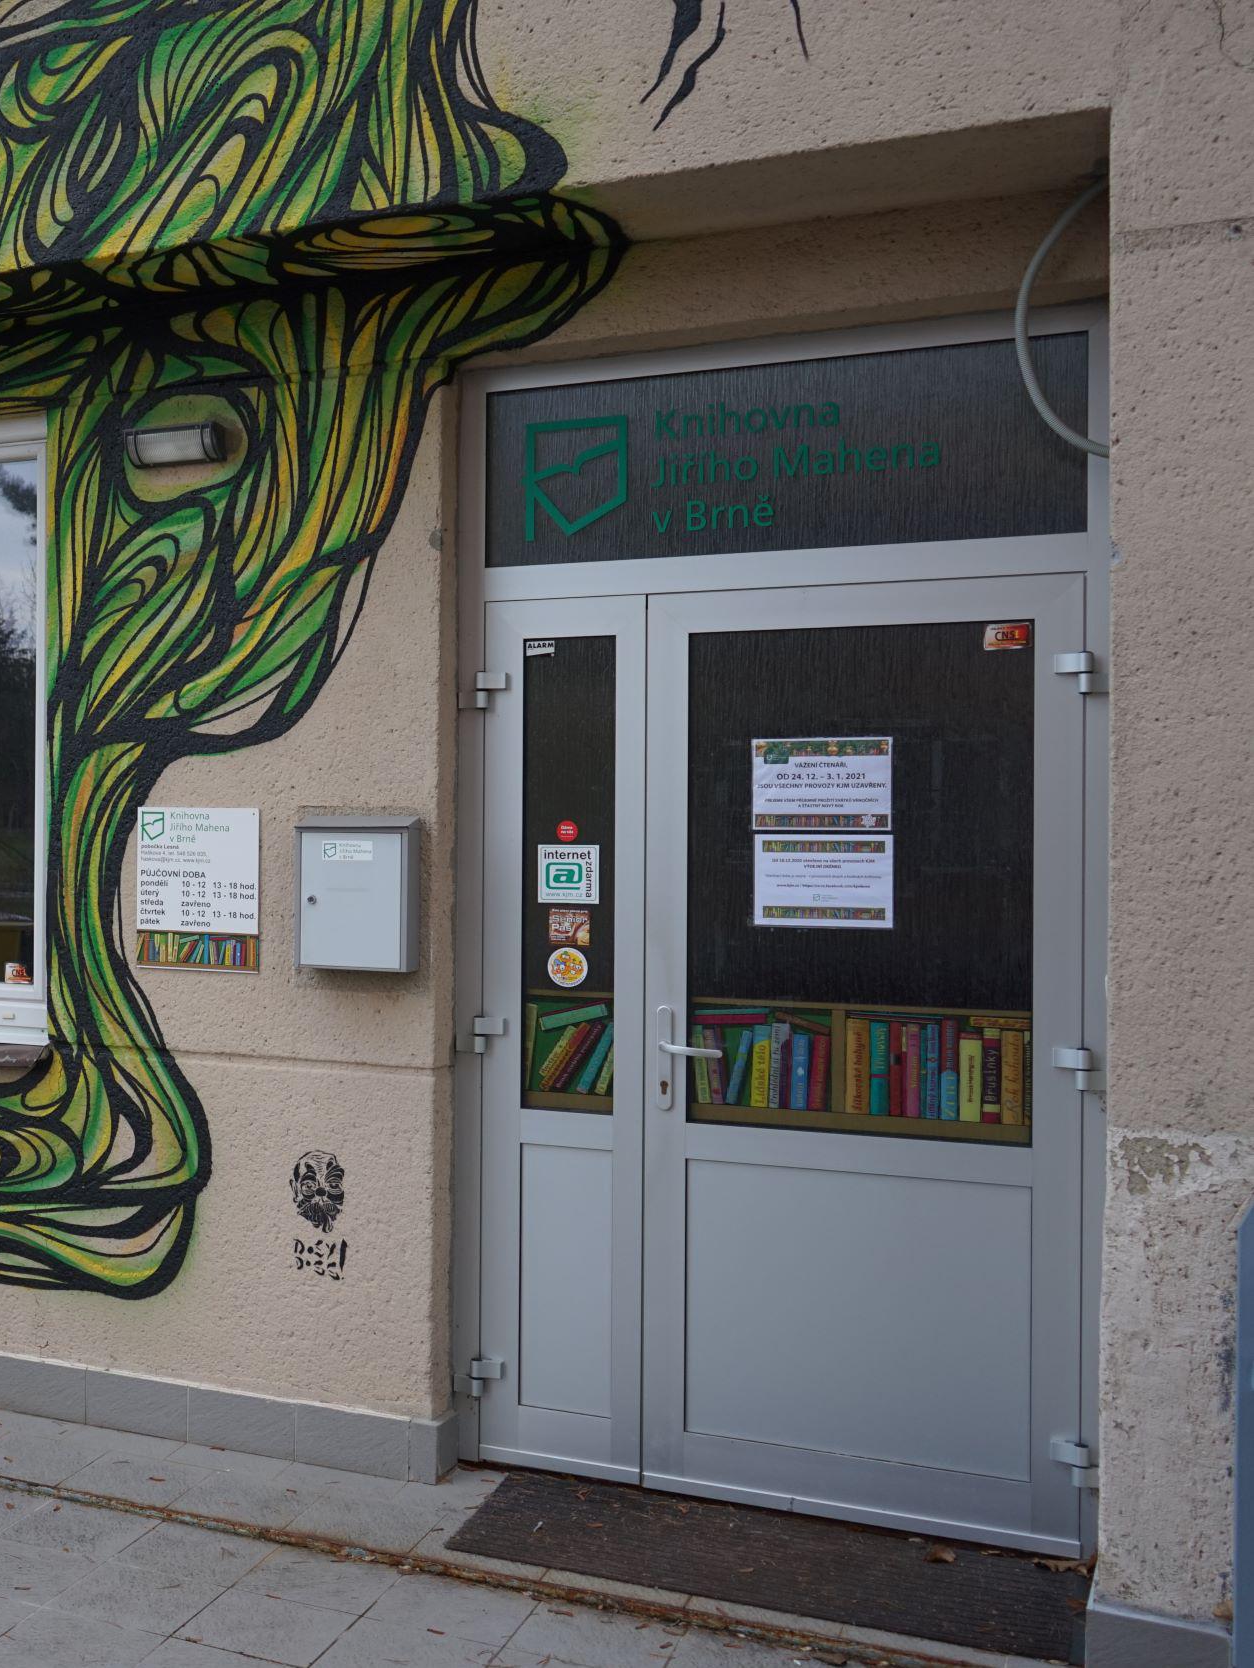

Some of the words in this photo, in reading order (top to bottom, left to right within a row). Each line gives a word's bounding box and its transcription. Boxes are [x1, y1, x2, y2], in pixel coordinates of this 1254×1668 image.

[653, 400, 841, 440] Knihovna
[650, 450, 758, 489] Jiřího
[772, 436, 942, 479] Mahena
[652, 510, 672, 533] v
[685, 494, 776, 532] Brně
[170, 811, 210, 820] Knihovna
[169, 823, 193, 832] Jiřího
[195, 823, 230, 832] Mahena
[176, 835, 196, 843] Brně
[543, 850, 592, 860] internet
[140, 868, 181, 878] PŮJČOVNÍ
[140, 880, 168, 888] pondělí
[586, 861, 594, 898] zdarma
[140, 889, 159, 897] úterý
[181, 900, 211, 908] zavřeno
[140, 908, 166, 916] čtvrtek
[197, 910, 206, 918] 12
[212, 911, 222, 919] 13
[228, 911, 237, 919] 18
[239, 911, 257, 919] hod.
[180, 919, 211, 927] zavřeno
[552, 914, 588, 923] Senior
[552, 923, 572, 931] Pas
[984, 1049, 997, 1102] Brusinky
